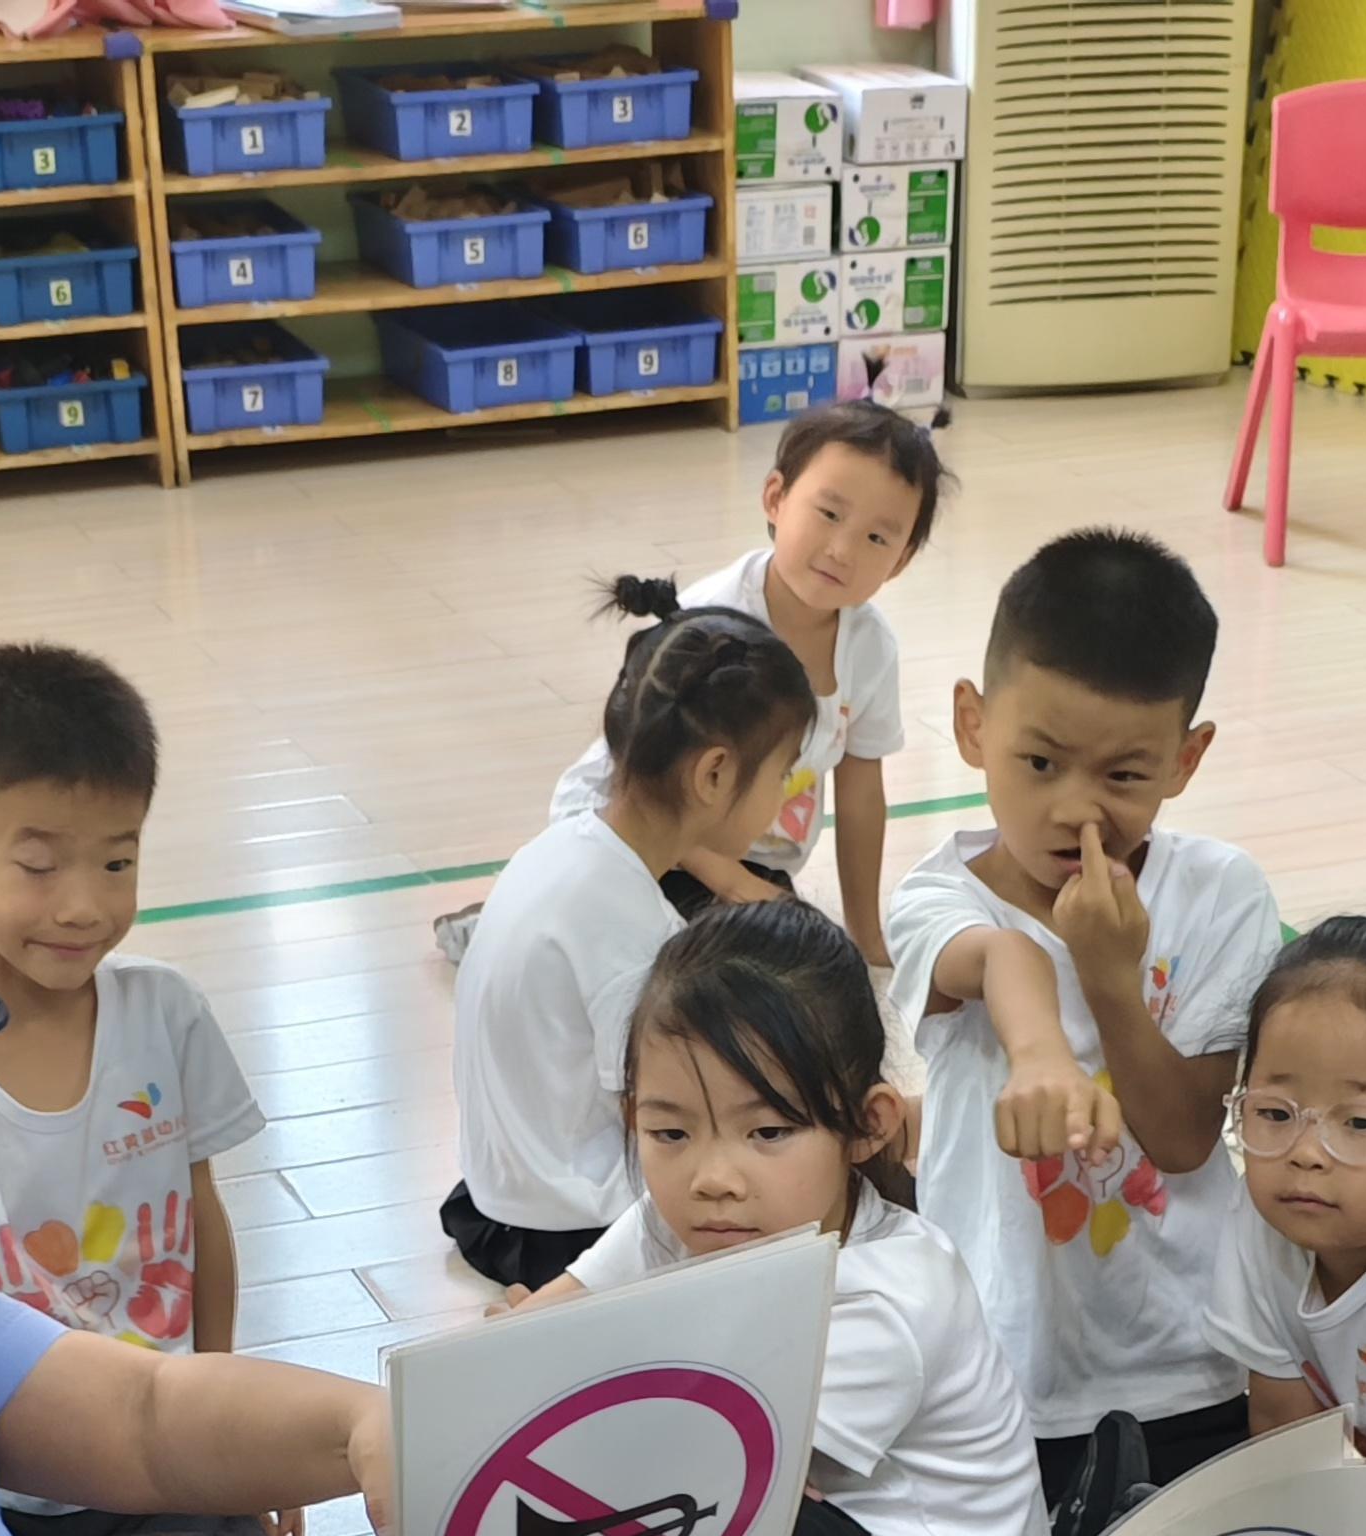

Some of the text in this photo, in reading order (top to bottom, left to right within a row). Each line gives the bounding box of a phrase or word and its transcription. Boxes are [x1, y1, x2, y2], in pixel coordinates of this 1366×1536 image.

[619, 99, 628, 118] 3
[456, 113, 467, 132] 2
[249, 130, 259, 149] 1
[41, 152, 51, 170] 3
[634, 227, 644, 245] 6
[469, 242, 480, 260] 5
[236, 262, 248, 279] 4
[56, 286, 68, 302] 6
[643, 354, 654, 372] 9
[504, 364, 513, 381] 8
[249, 390, 260, 409] 7
[67, 406, 79, 424] 9
